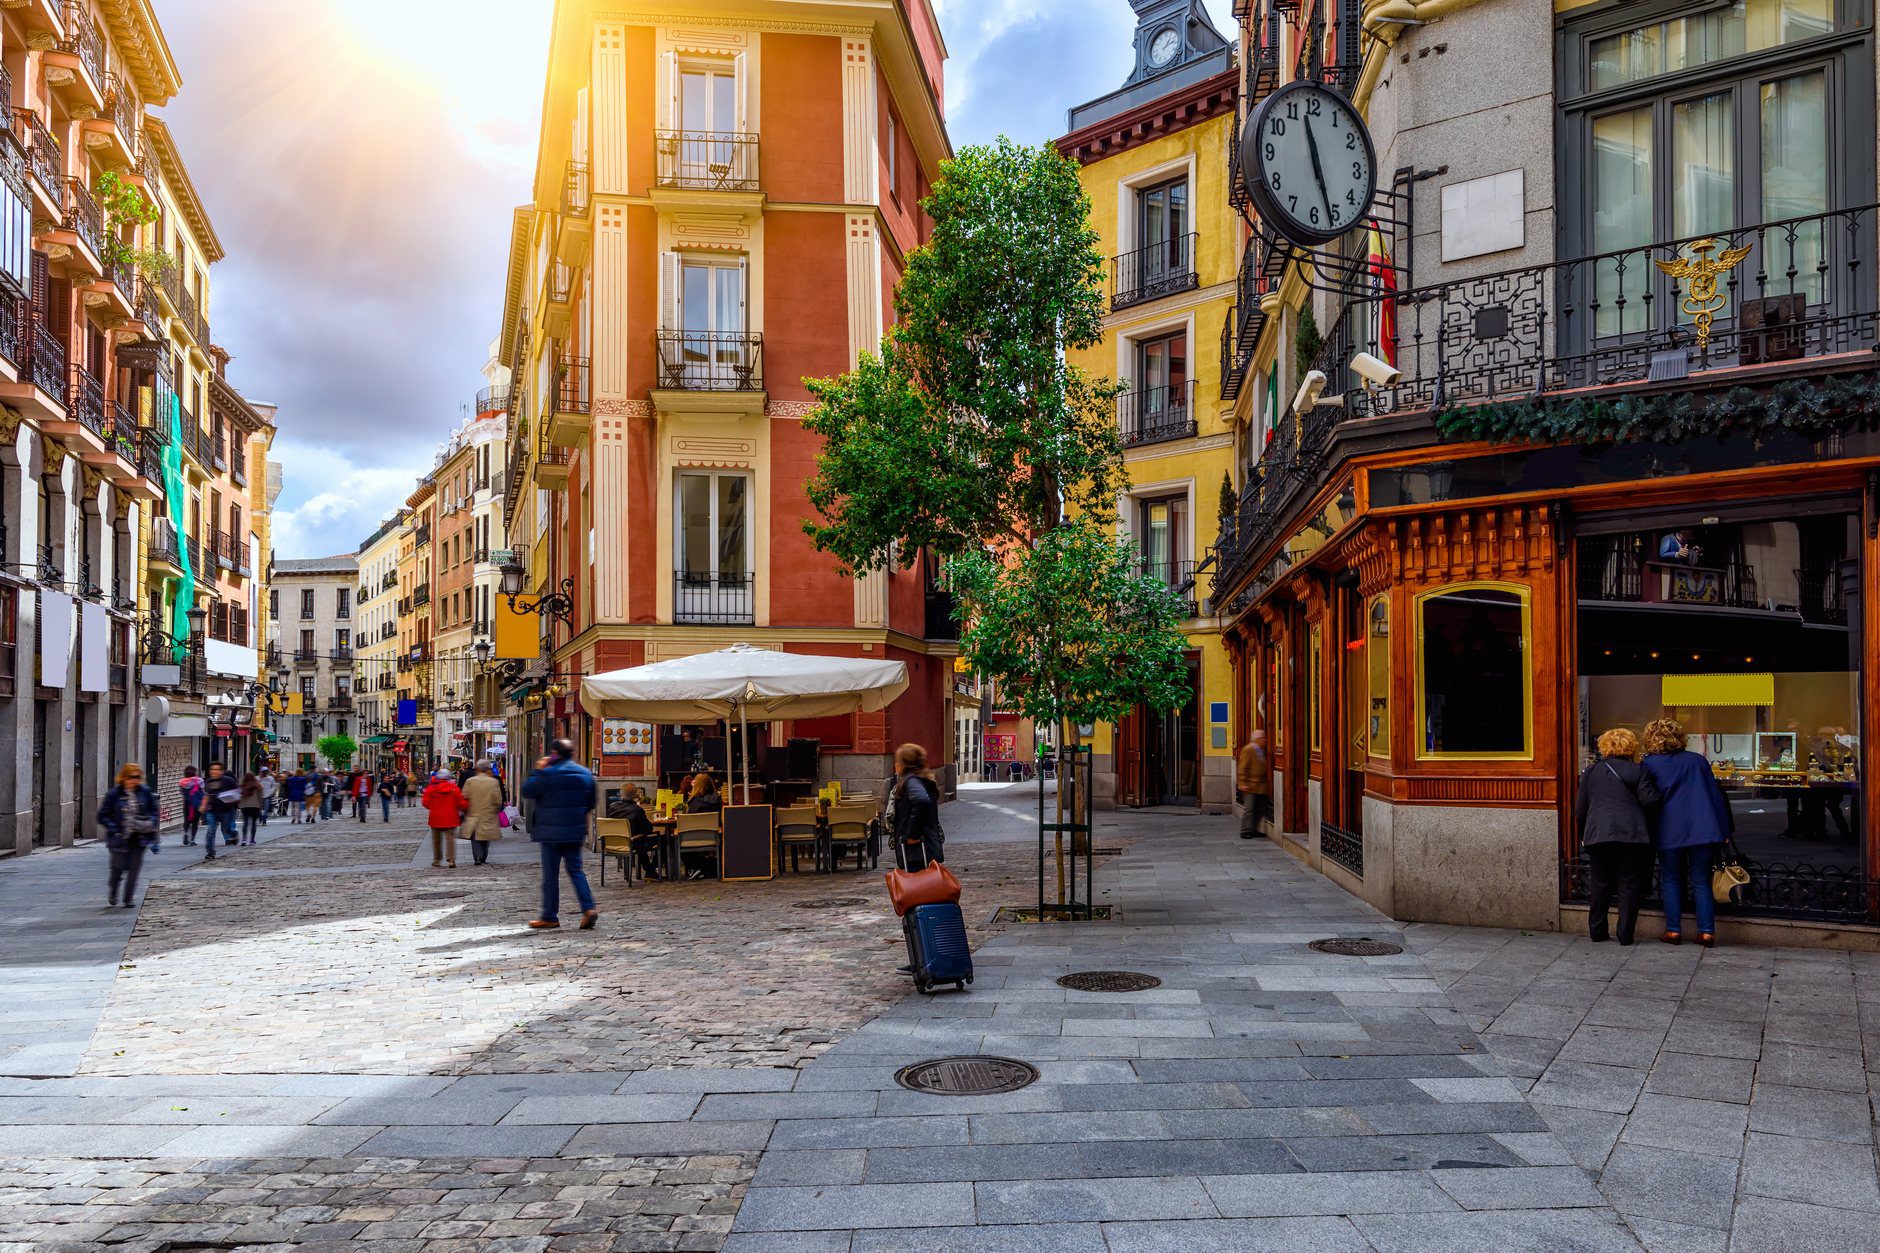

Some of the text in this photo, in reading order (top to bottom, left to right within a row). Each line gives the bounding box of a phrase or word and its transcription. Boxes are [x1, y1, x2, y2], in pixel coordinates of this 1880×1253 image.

[1287, 101, 1299, 120] 11
[1305, 98, 1321, 117] 12
[1270, 118, 1286, 136] 10
[1331, 110, 1338, 128] 1
[1346, 132, 1355, 150] 2
[1265, 143, 1275, 161] 9
[1352, 162, 1361, 180] 3
[1272, 172, 1281, 190] 8
[1288, 195, 1298, 213] 7
[1346, 188, 1355, 205] 4
[1309, 206, 1319, 225] 6
[1331, 204, 1340, 222] 5
